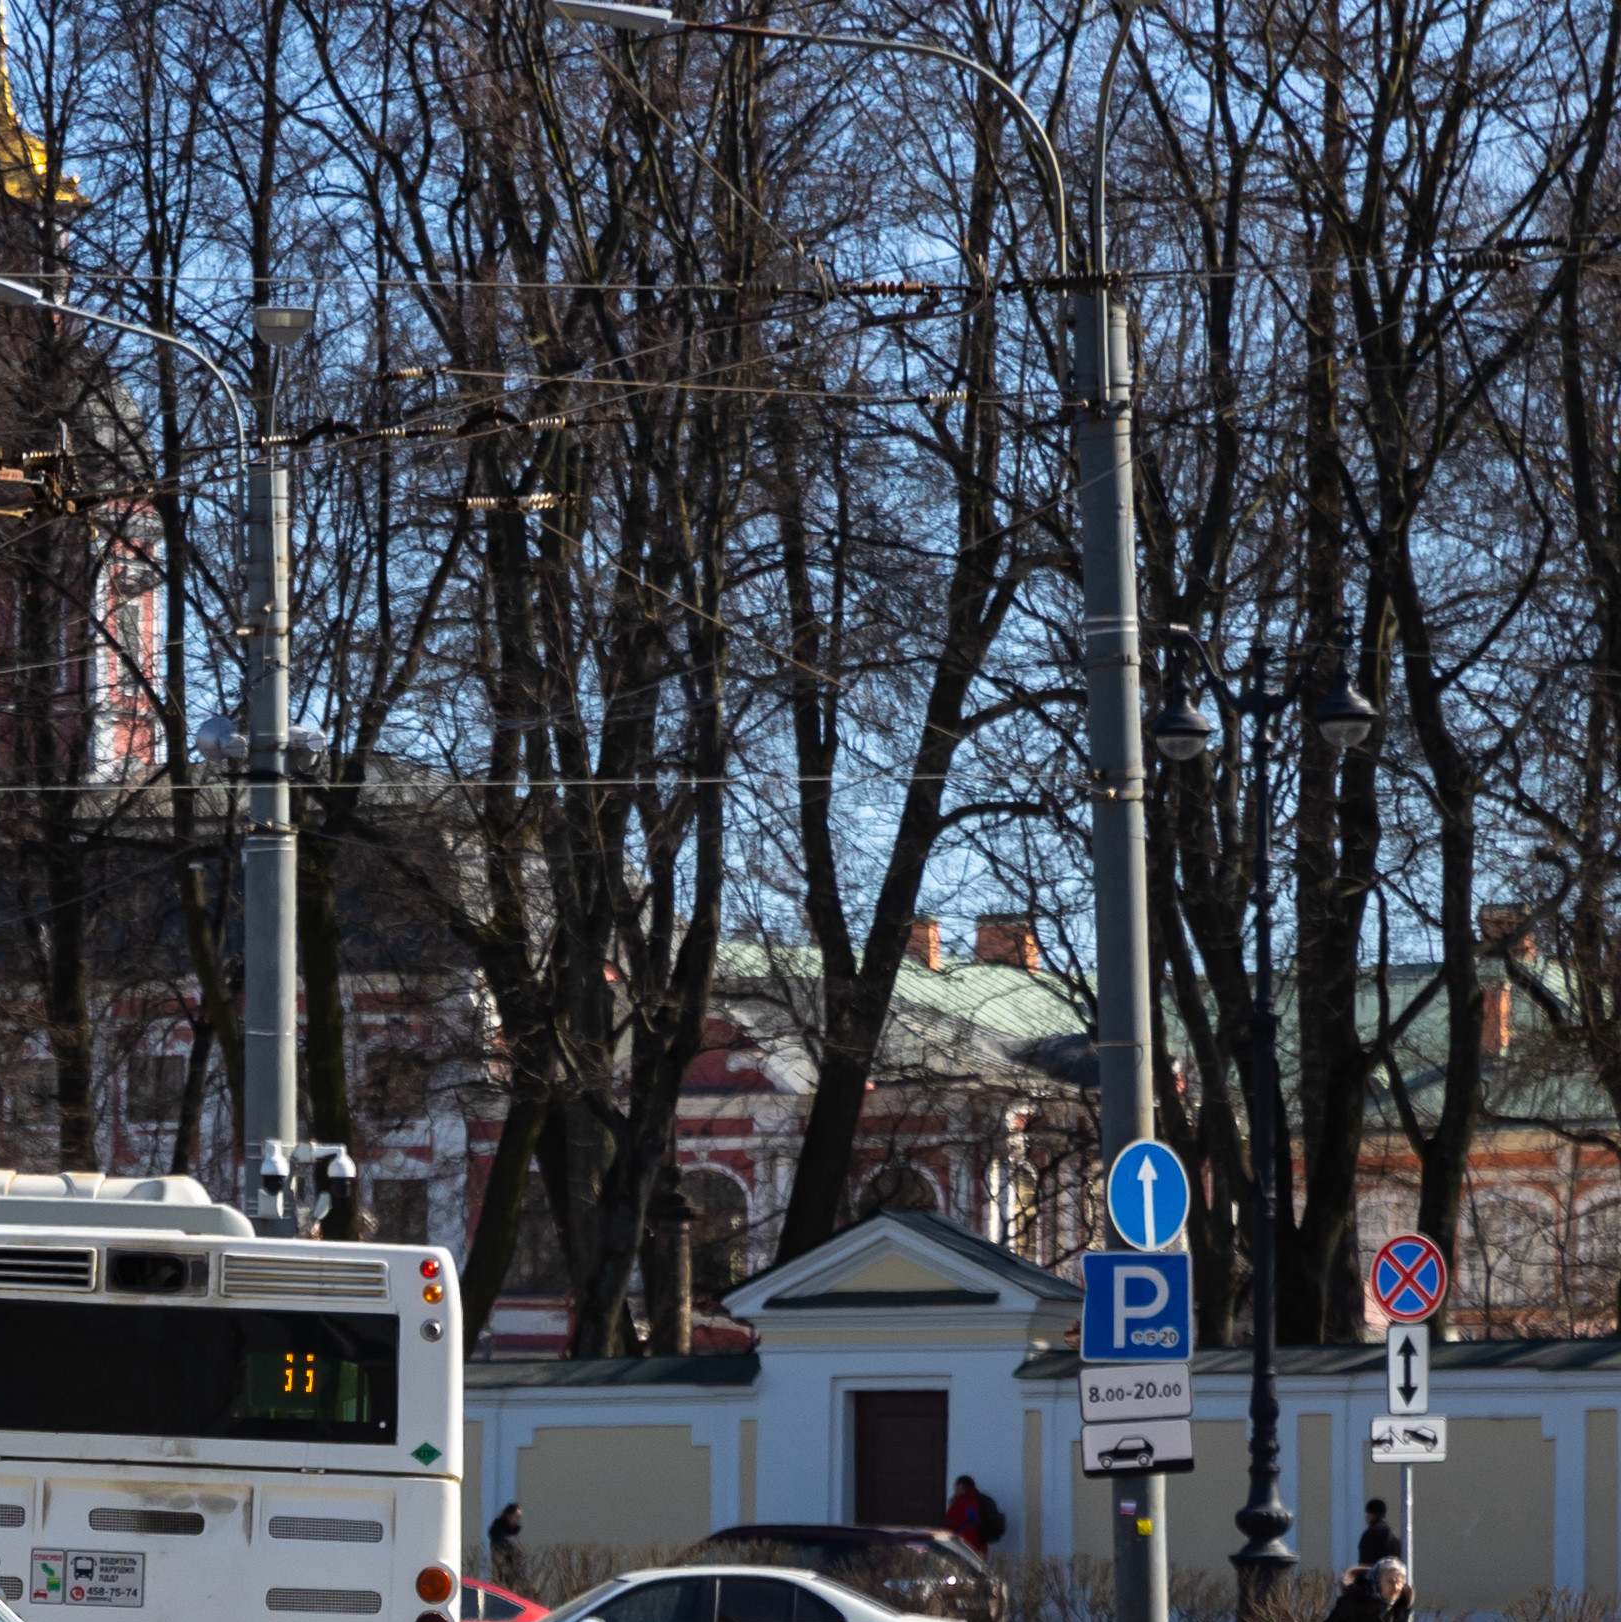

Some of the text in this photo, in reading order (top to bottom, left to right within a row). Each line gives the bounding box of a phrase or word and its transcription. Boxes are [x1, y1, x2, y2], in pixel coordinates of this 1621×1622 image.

[1113, 1266, 1169, 1348] P
[1161, 1330, 1177, 1344] 20
[1088, 1381, 1182, 1403] 8.00-20.00
[86, 1586, 138, 1598] 458-75-74
